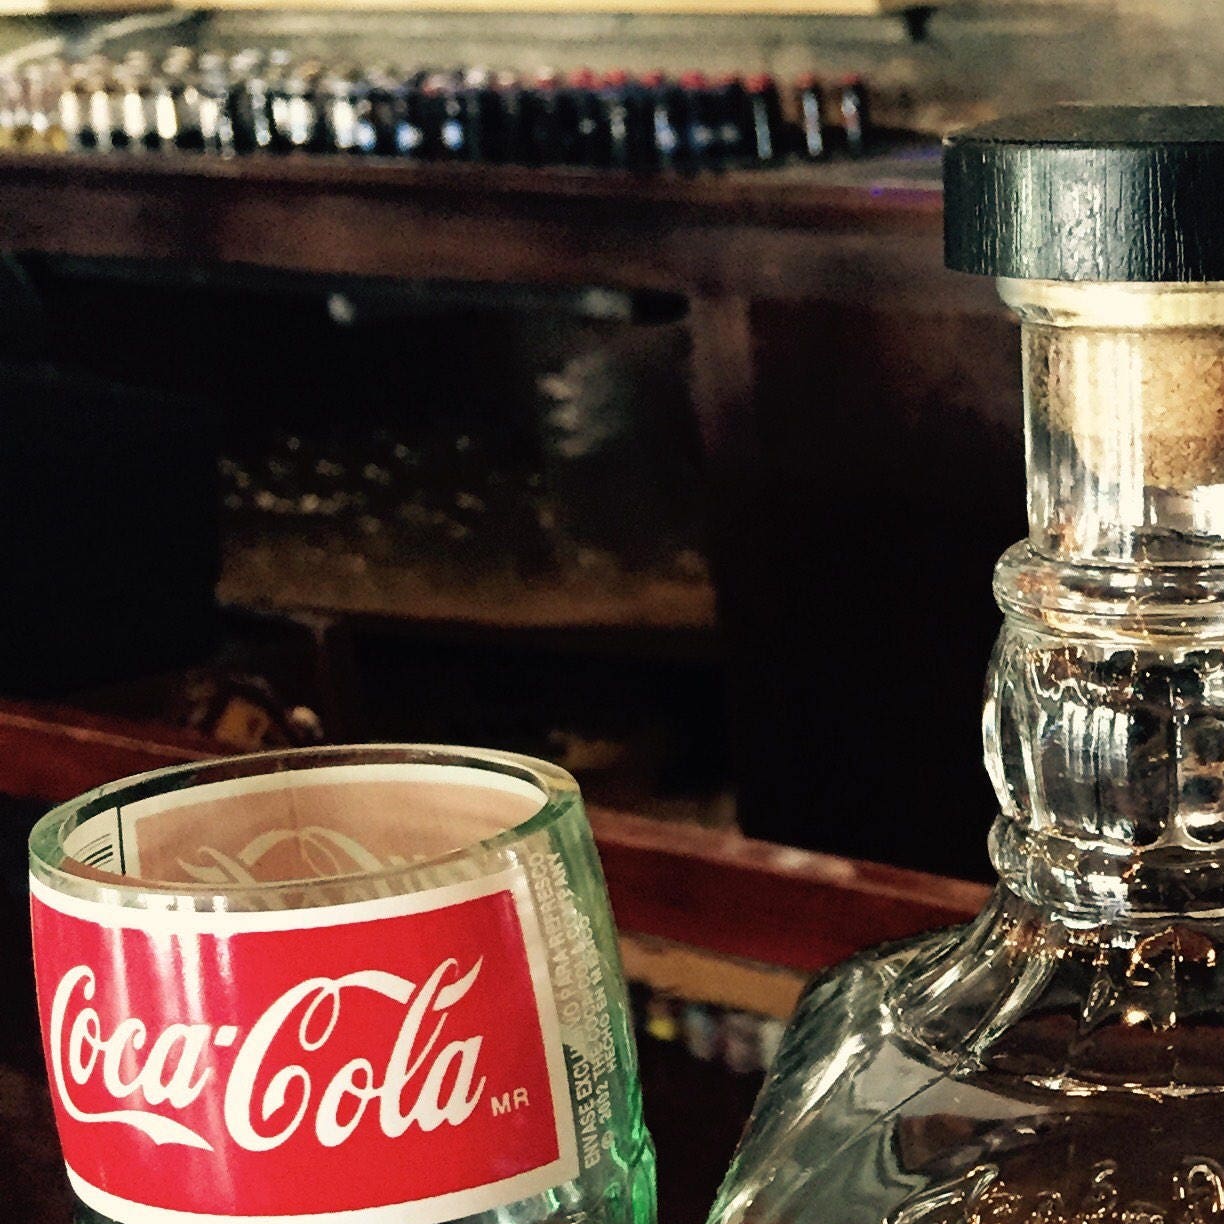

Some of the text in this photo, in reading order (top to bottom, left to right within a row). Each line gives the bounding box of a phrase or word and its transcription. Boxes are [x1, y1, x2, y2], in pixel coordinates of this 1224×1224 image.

[528, 852, 566, 948] REFRESCO
[552, 948, 577, 999] PARA
[50, 956, 485, 1152] Coca-Cola
[600, 1012, 617, 1073] HECHO
[490, 1087, 530, 1118] MR
[578, 1097, 600, 1169] ENVASE
[595, 1080, 613, 1125] 2002
